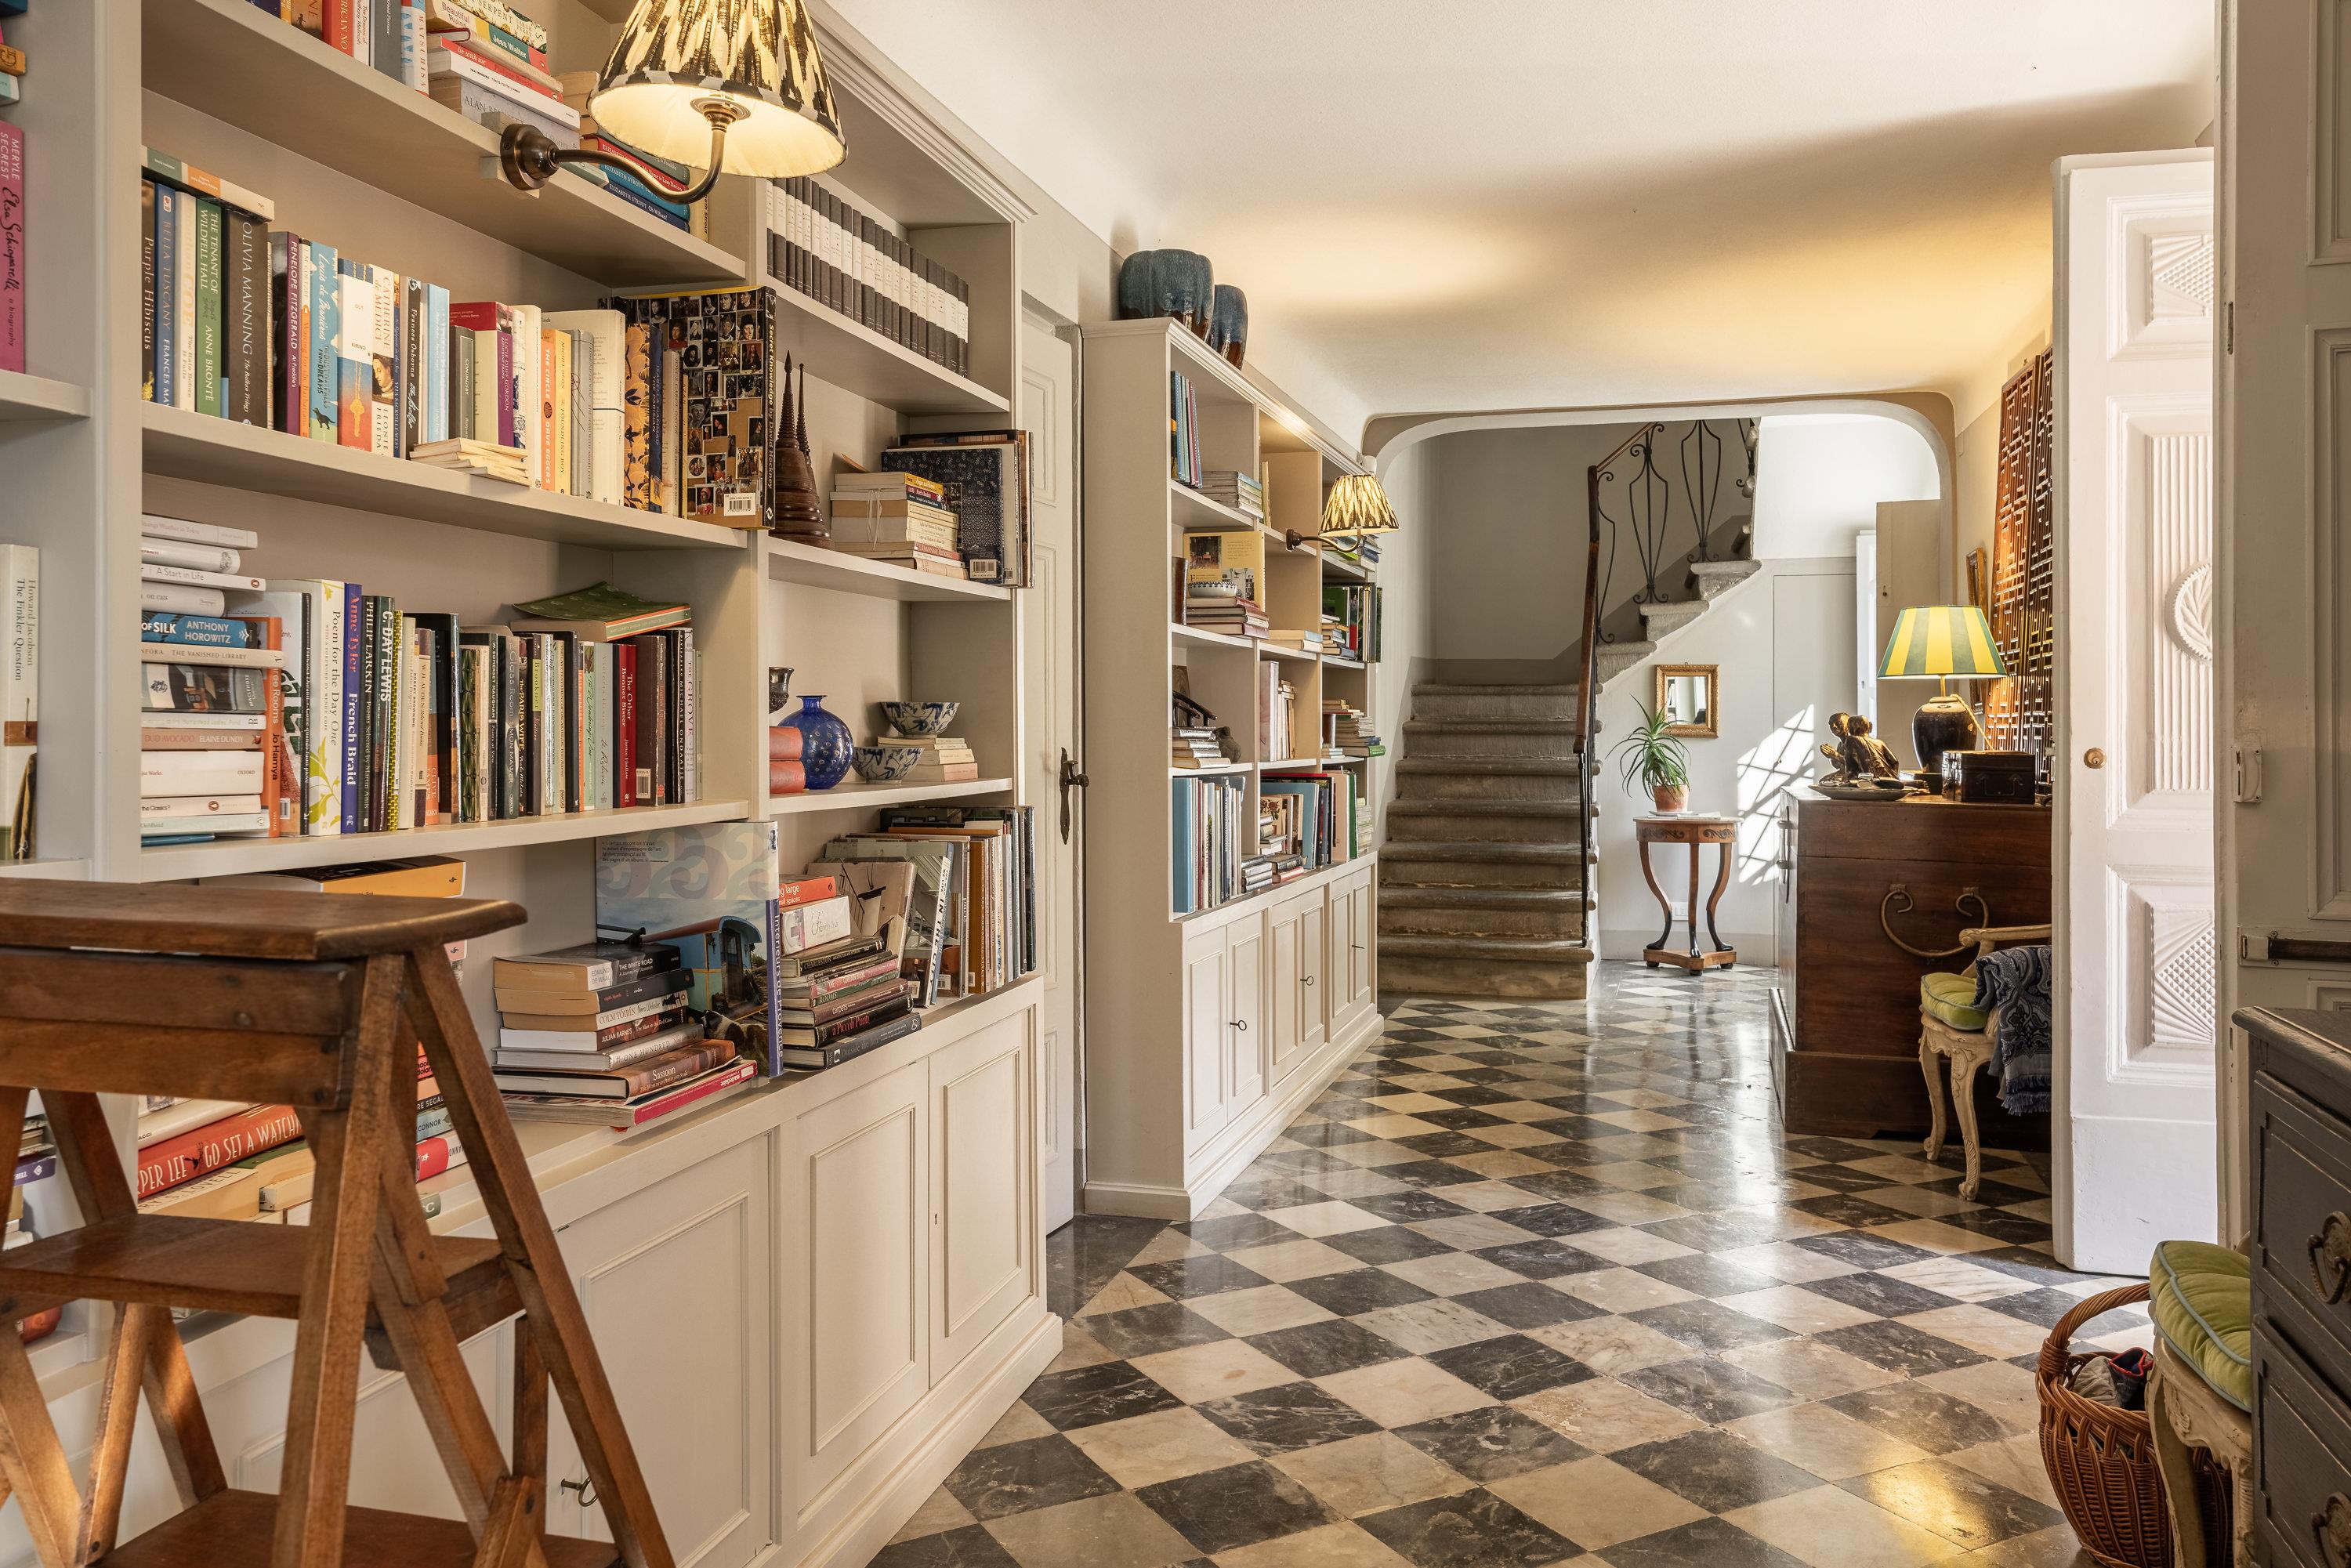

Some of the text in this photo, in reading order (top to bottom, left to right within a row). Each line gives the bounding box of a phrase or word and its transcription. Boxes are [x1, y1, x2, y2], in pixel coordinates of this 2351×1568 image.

[442, 2, 469, 24] Beautiful
[493, 35, 527, 58] Jess Walter
[464, 96, 487, 113] ALAN
[0, 132, 9, 179] SECREST
[12, 139, 20, 180] MERYLE
[2, 187, 20, 220] Elsa
[609, 184, 647, 208] ELIZABETH STROUT
[319, 253, 330, 281] Louis
[143, 237, 154, 349] Purple Hibiscus
[211, 279, 219, 295] OF
[242, 222, 252, 356] OLIVIA MANNING
[205, 359, 215, 401] BRONTË
[767, 407, 774, 419] by
[164, 568, 182, 578] Start
[191, 571, 205, 581] Life
[14, 579, 25, 681] The Finkler Question
[154, 621, 176, 634] SILK
[187, 620, 229, 632] ANTHONY
[332, 611, 341, 643] Poem
[349, 596, 359, 672] Anne Tyler
[185, 632, 231, 643] HOROWITZ
[380, 610, 393, 702] C. DAY LEWIS
[331, 668, 340, 687] the
[329, 693, 339, 716] Day
[199, 735, 220, 744] ELAINE
[220, 735, 244, 744] DUNDY
[347, 693, 358, 785] French Braid
[271, 733, 281, 780] Jo Hamya
[785, 885, 800, 895] large
[787, 896, 800, 905] spaces
[939, 898, 944, 914] IN
[933, 920, 942, 946] THE
[591, 967, 610, 976] EDMUND
[628, 960, 641, 969] WHITE
[804, 956, 831, 970] CHARLESTON
[777, 980, 782, 995] de
[819, 992, 838, 1004] ROOMS
[599, 1001, 661, 1024] COLM Webster
[832, 1004, 849, 1016] carpets
[601, 1028, 632, 1043] JULIAN BARNES
[836, 1017, 855, 1034] Piccoli
[624, 1041, 670, 1062] ONE HUNDRED
[652, 1066, 676, 1081] Sassoon
[167, 1155, 187, 1182] LEE
[204, 1143, 220, 1168] GO
[223, 1134, 242, 1161] SET
[247, 1131, 255, 1153] A
